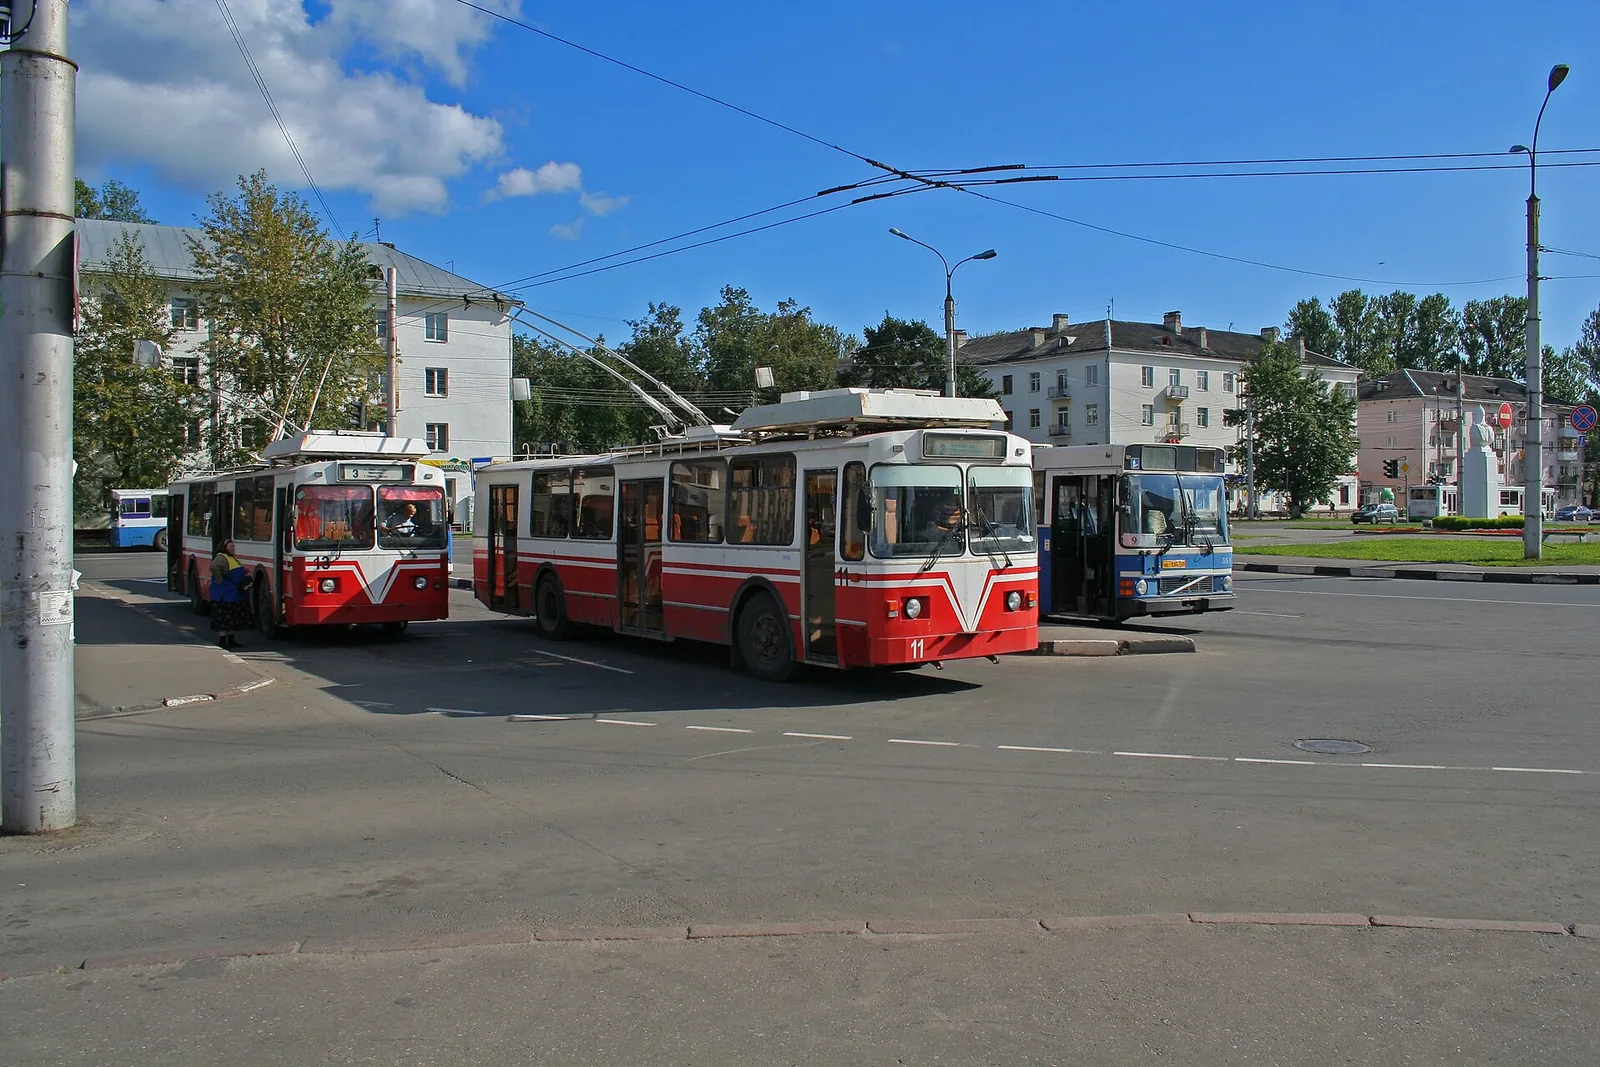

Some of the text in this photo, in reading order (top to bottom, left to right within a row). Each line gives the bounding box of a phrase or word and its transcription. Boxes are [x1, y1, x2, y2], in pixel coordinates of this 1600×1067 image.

[353, 469, 359, 478] 3
[1131, 536, 1138, 546] 9
[313, 556, 330, 570] 13
[837, 566, 849, 586] 11
[911, 638, 924, 659] 11
